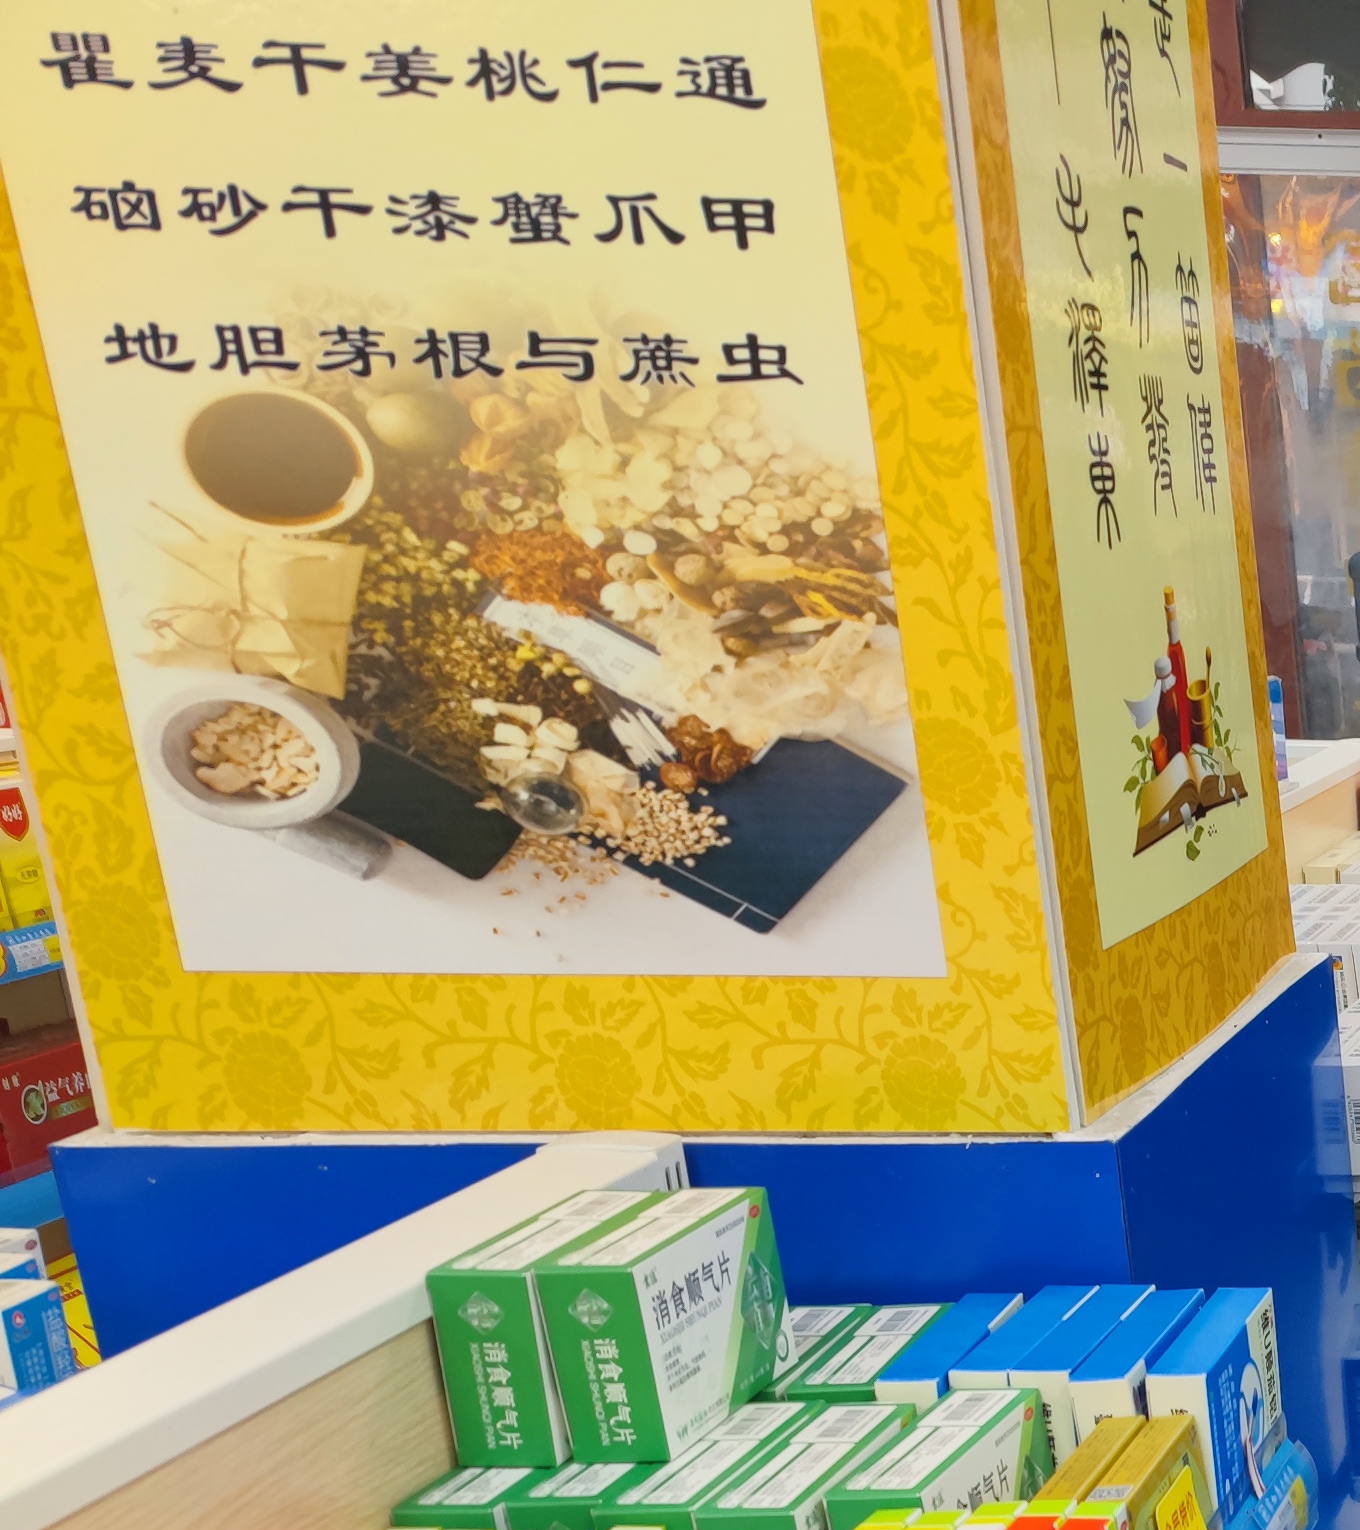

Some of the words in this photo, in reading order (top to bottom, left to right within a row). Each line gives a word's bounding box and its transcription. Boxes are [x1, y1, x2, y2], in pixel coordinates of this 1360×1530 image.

[39, 30, 768, 109] 瞿麦干姜桃仁通
[70, 181, 777, 250] 硇砂干漆蟹爪甲
[650, 1250, 733, 1331] 消食顺气片
[482, 1342, 523, 1450] 消食顺气片
[593, 1338, 637, 1446] 消食顺气片
